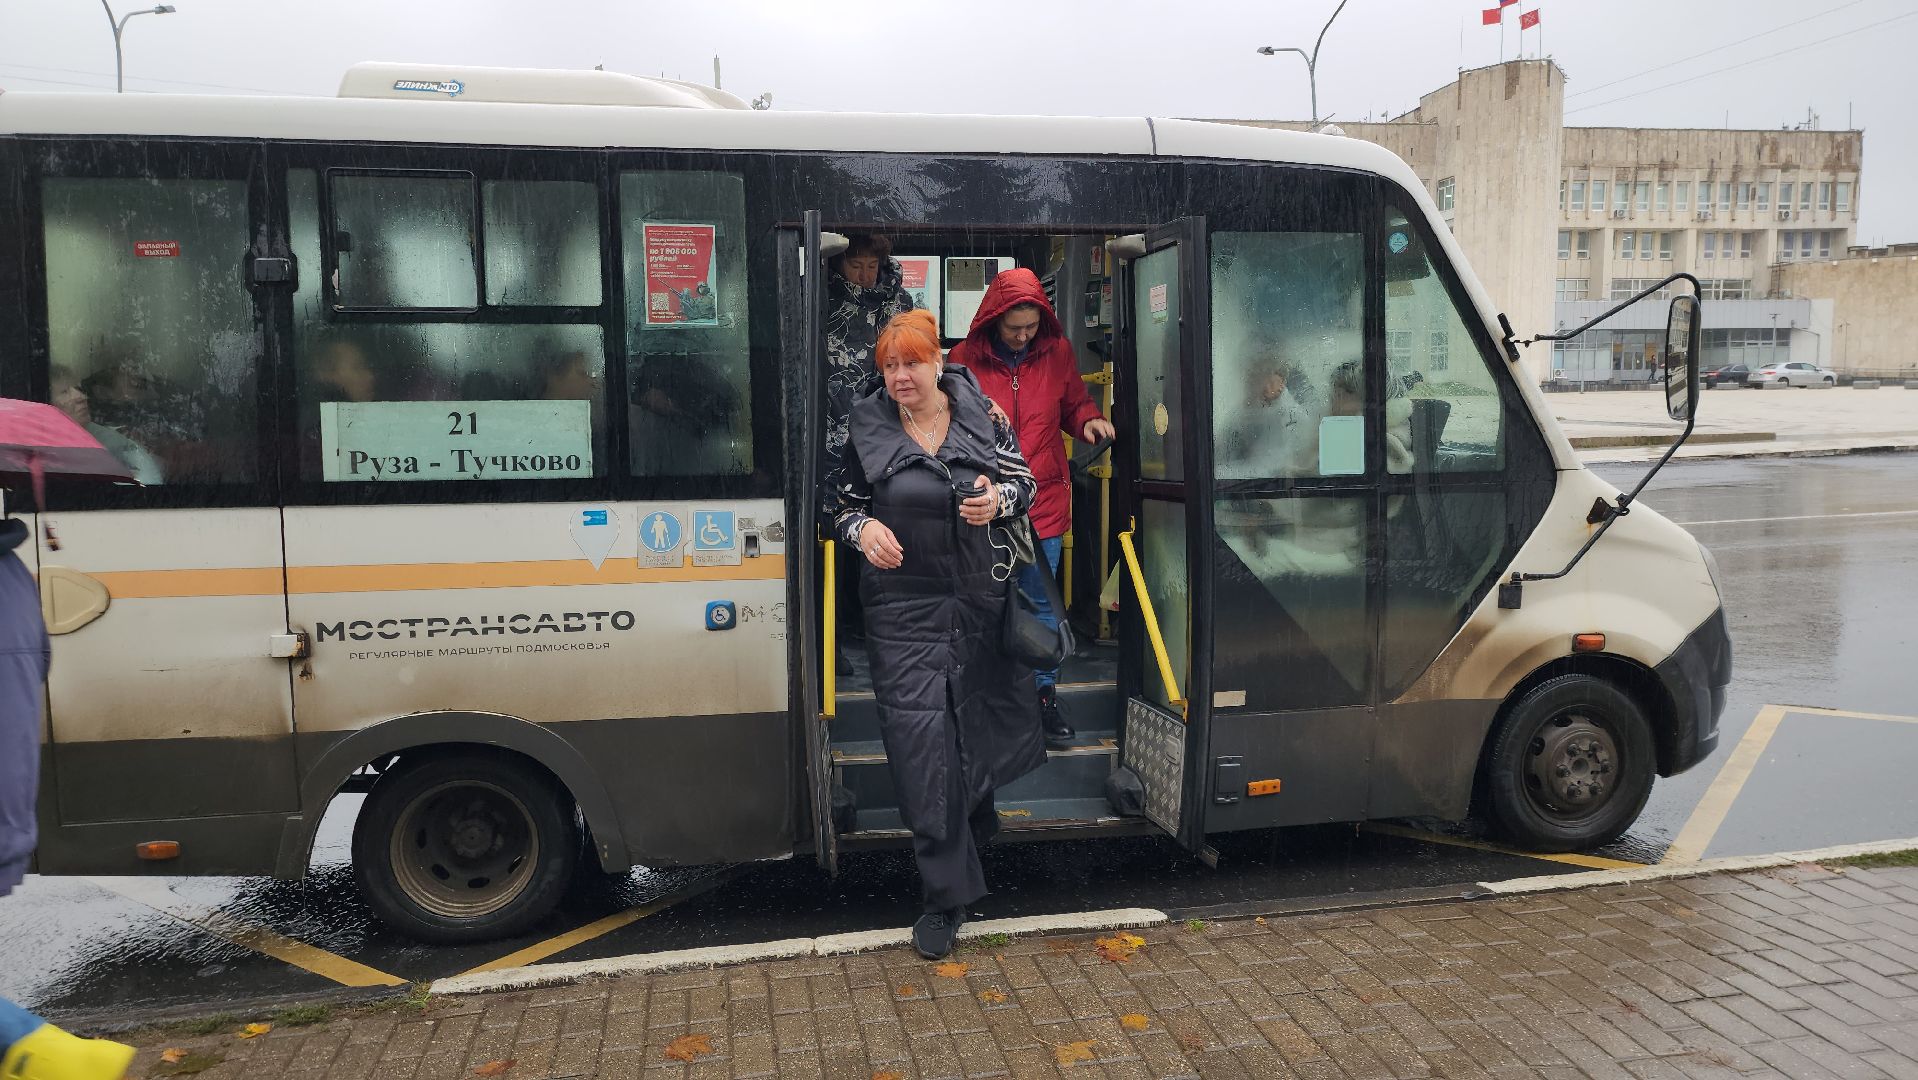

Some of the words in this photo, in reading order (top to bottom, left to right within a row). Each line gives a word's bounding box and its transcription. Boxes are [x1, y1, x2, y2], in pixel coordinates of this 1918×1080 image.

[447, 411, 478, 436] 21
[348, 450, 420, 481] Руза
[450, 449, 581, 479] Тучково
[315, 610, 636, 643] МОСТРАНСАВТО
[349, 649, 434, 660] РЕГУЛЯРНЫЕ
[438, 645, 513, 657] МАРШРУТЫ
[516, 642, 610, 653] ПОДМОСКОВЬЯ
